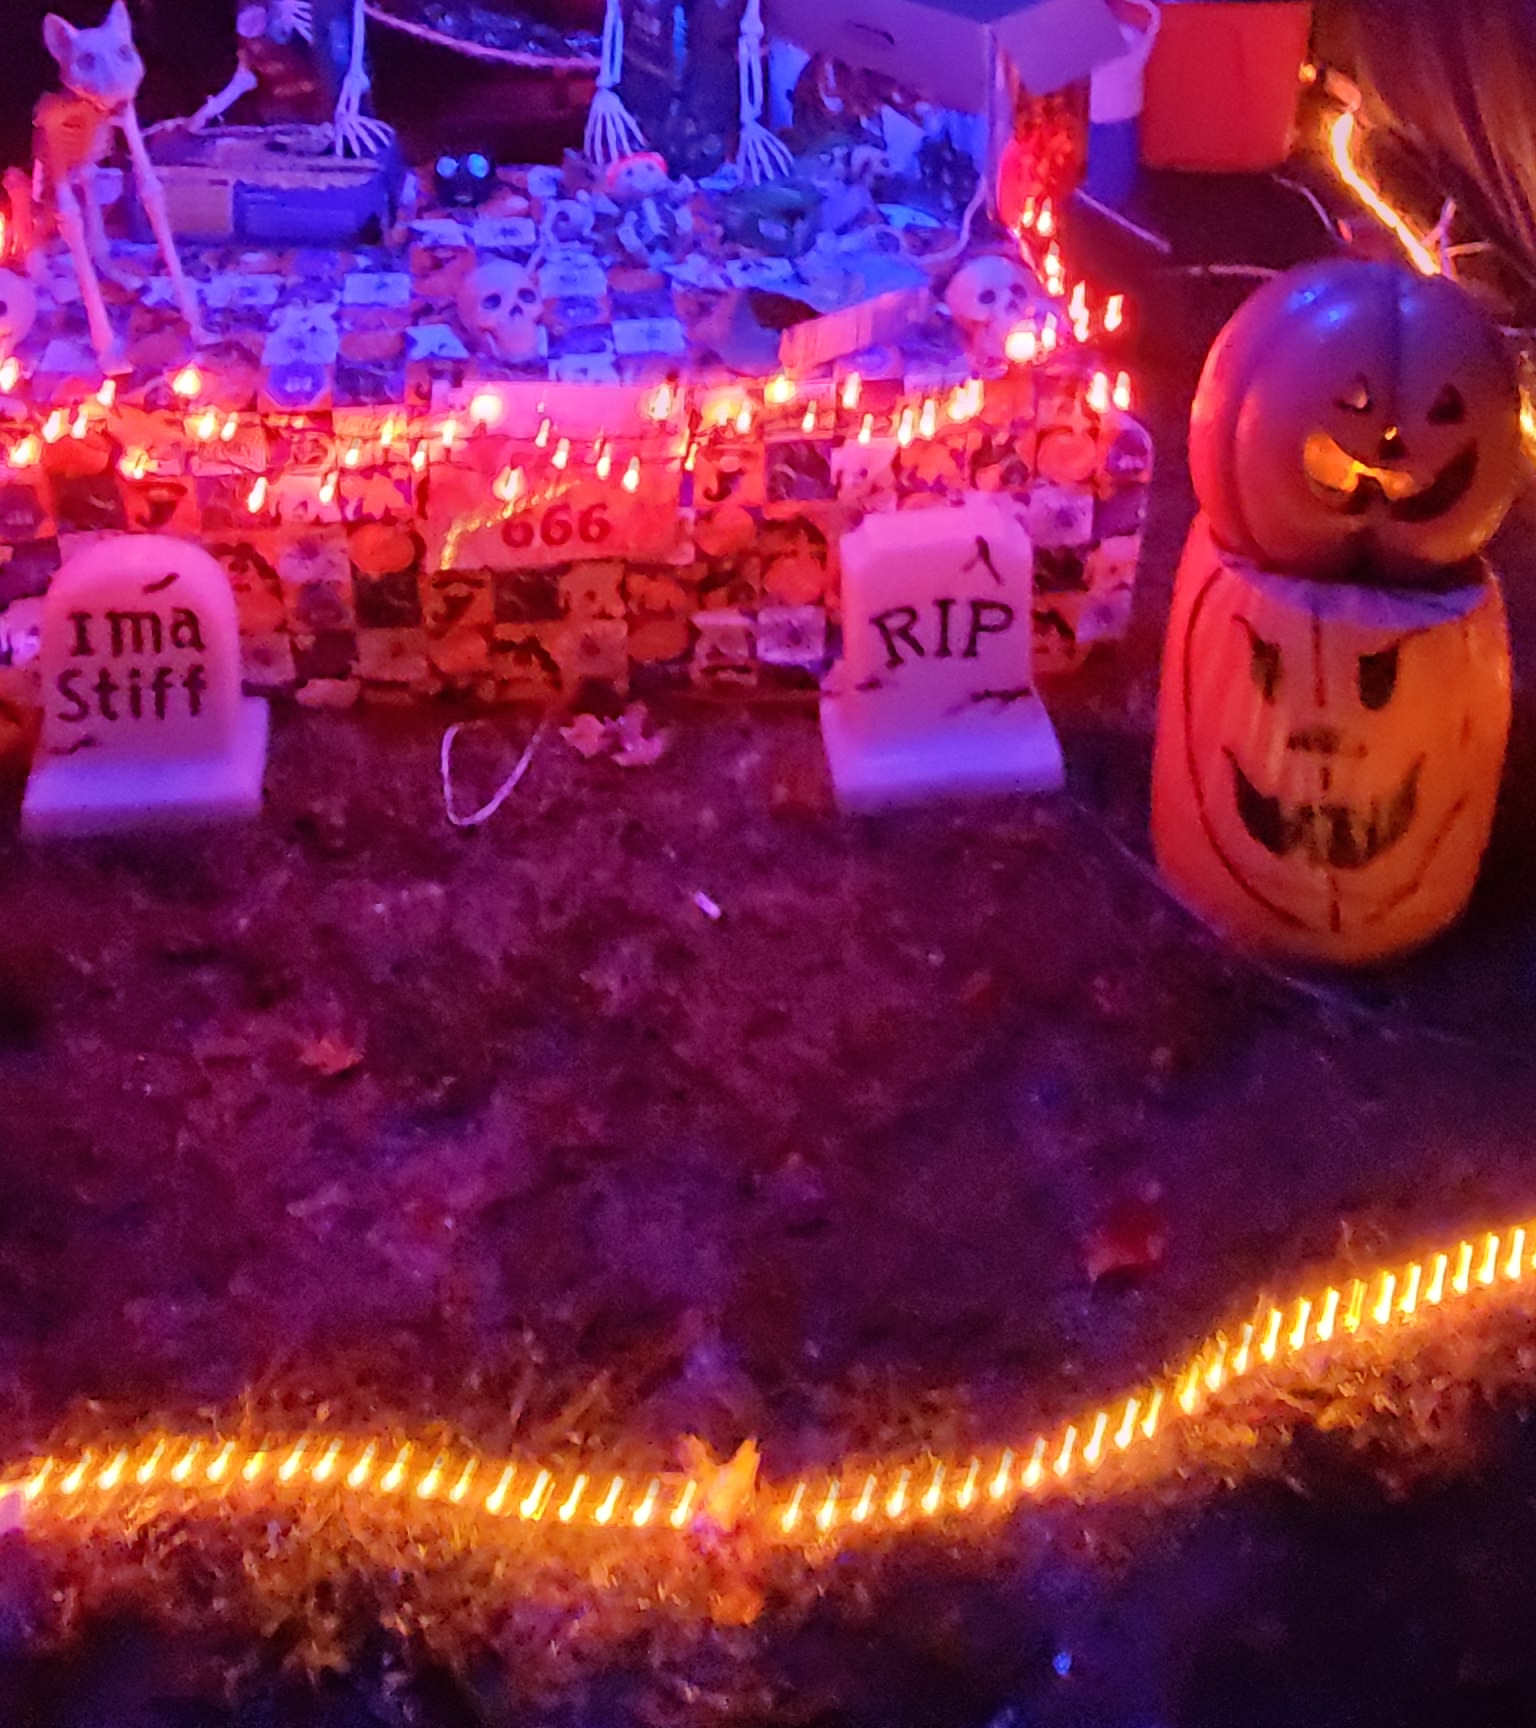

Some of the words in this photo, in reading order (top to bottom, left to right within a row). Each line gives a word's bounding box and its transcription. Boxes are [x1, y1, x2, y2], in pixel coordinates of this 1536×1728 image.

[501, 502, 612, 549] 666
[869, 598, 1015, 669] RIP
[56, 663, 208, 723] Stiff
